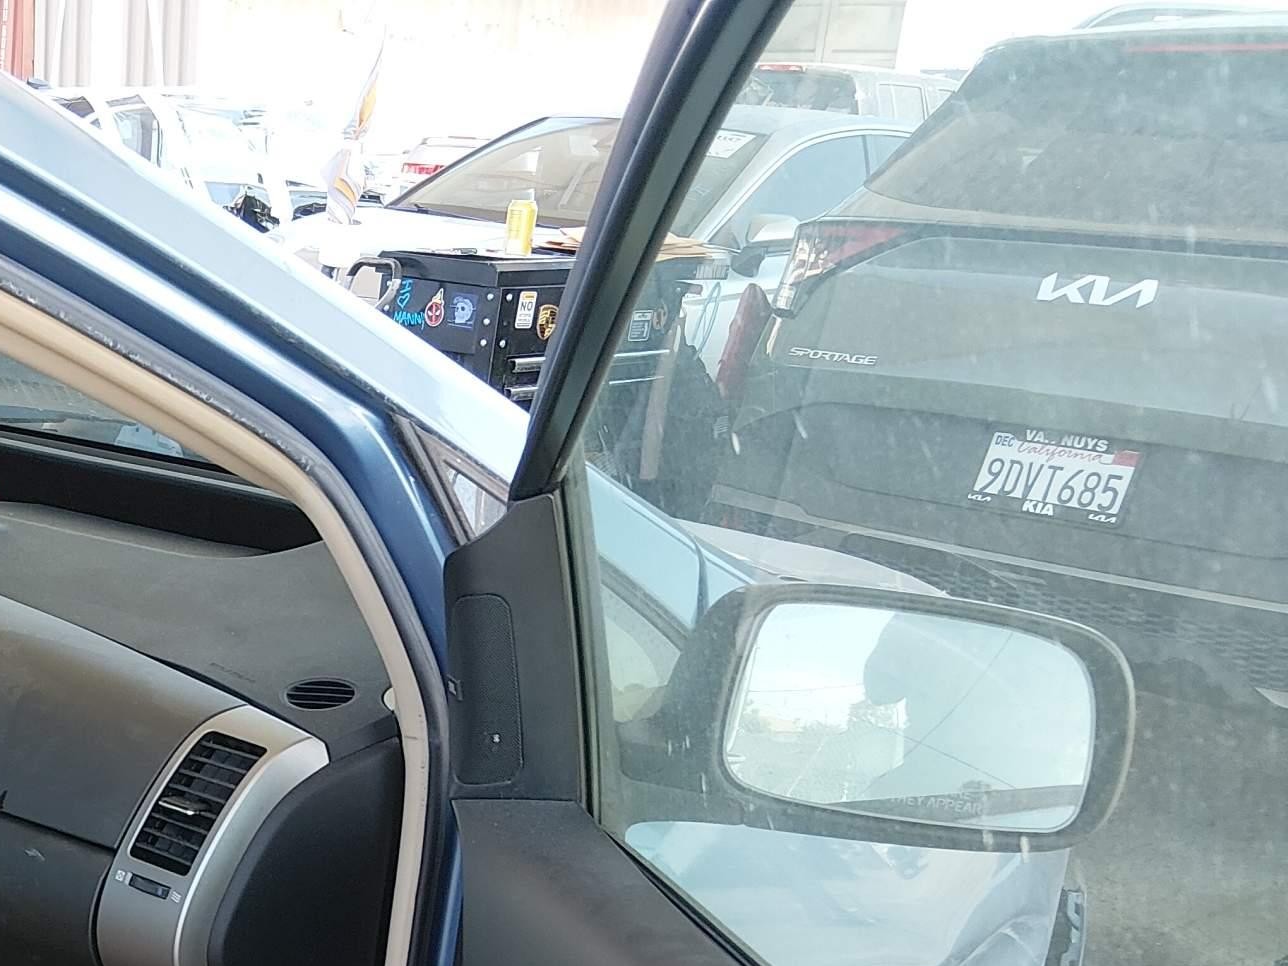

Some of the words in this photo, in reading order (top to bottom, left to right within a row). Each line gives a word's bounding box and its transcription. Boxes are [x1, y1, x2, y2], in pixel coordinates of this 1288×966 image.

[789, 346, 878, 365] SPORTAGE
[995, 434, 1015, 447] DEC
[1061, 435, 1109, 452] NUYS
[979, 457, 1124, 512] 9DVT685
[1022, 500, 1054, 516] KIA
[926, 797, 984, 816] APPEAR
